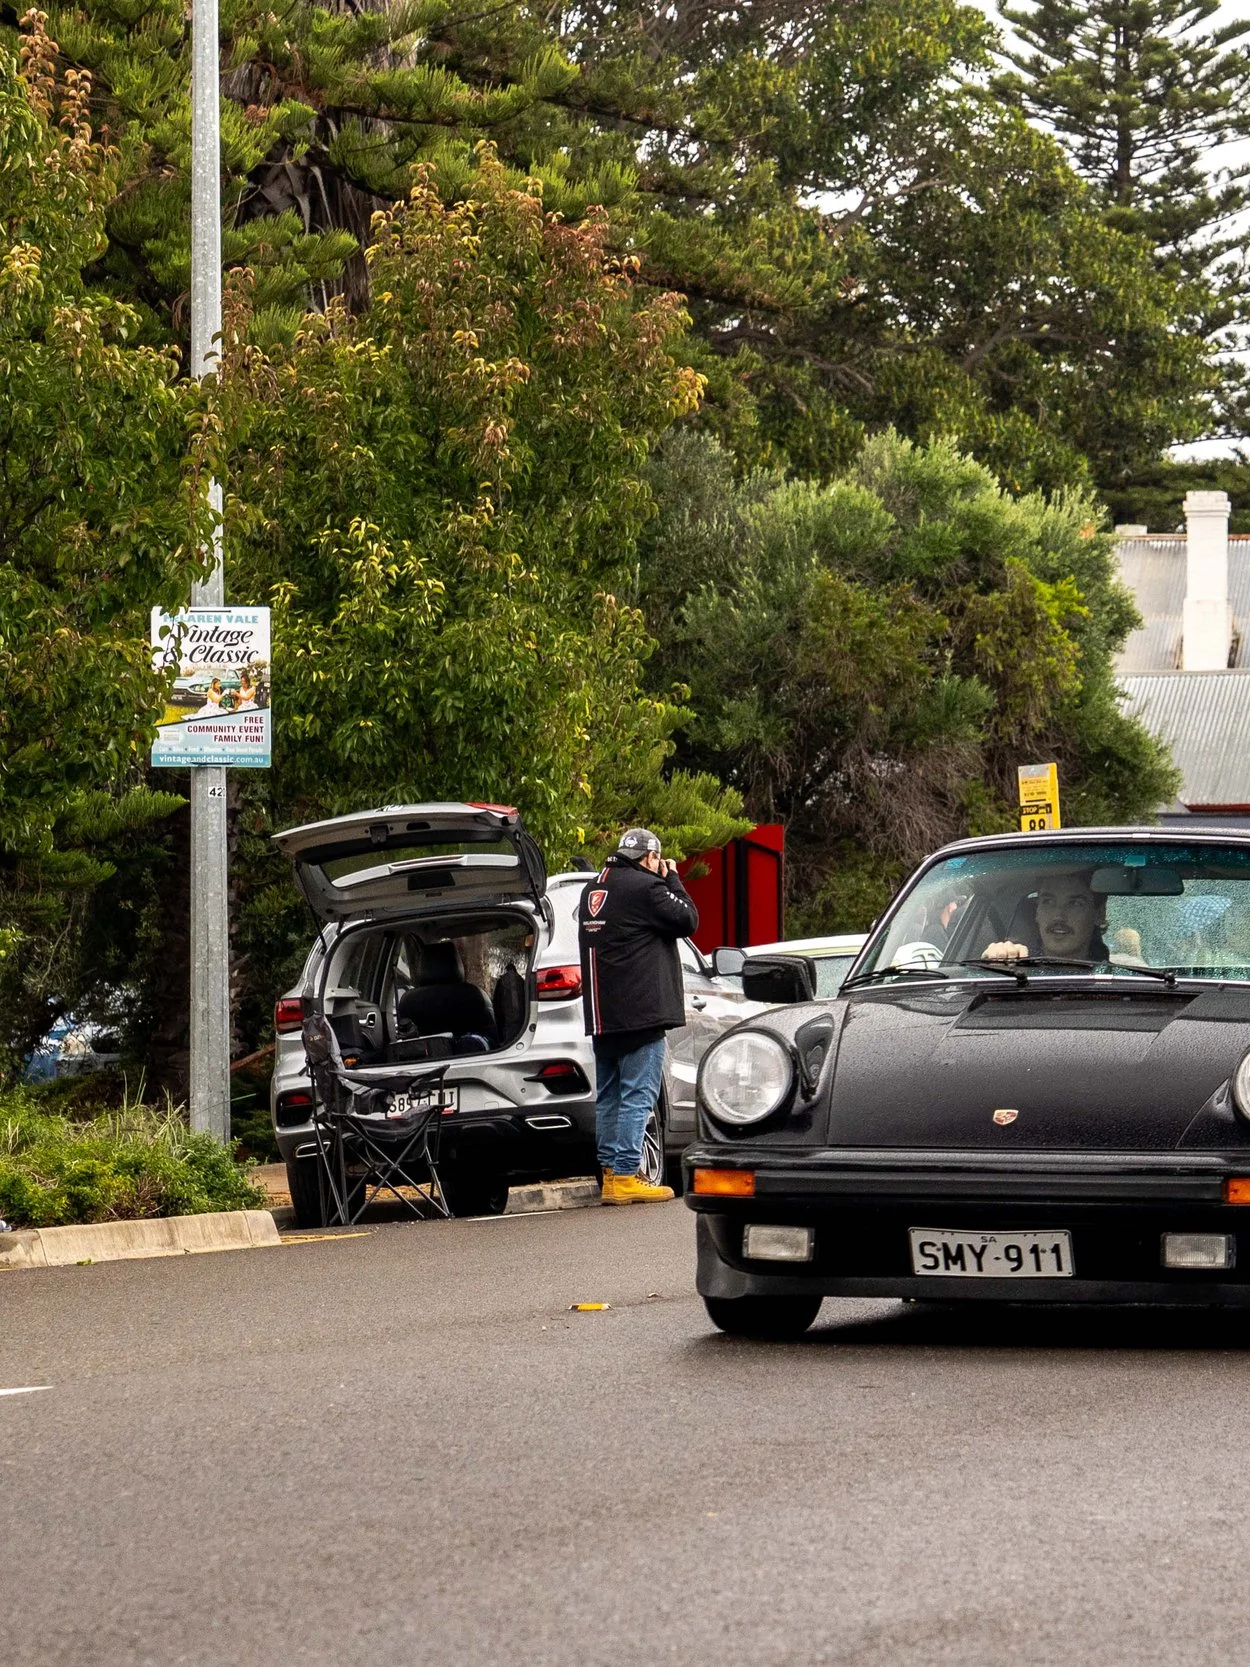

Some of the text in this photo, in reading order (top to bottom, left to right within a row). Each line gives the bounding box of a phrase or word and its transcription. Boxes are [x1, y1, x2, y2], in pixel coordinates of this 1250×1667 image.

[226, 615, 259, 624] VALE
[188, 644, 259, 664] Classic
[244, 716, 264, 724] FREE
[187, 725, 264, 733] COMMUNITY EVENT
[213, 734, 264, 743] FAMILY FUN!
[160, 754, 264, 764] vintageandclassic.com.au
[980, 1235, 998, 1244] SA
[919, 1241, 1063, 1272] SMY-911
